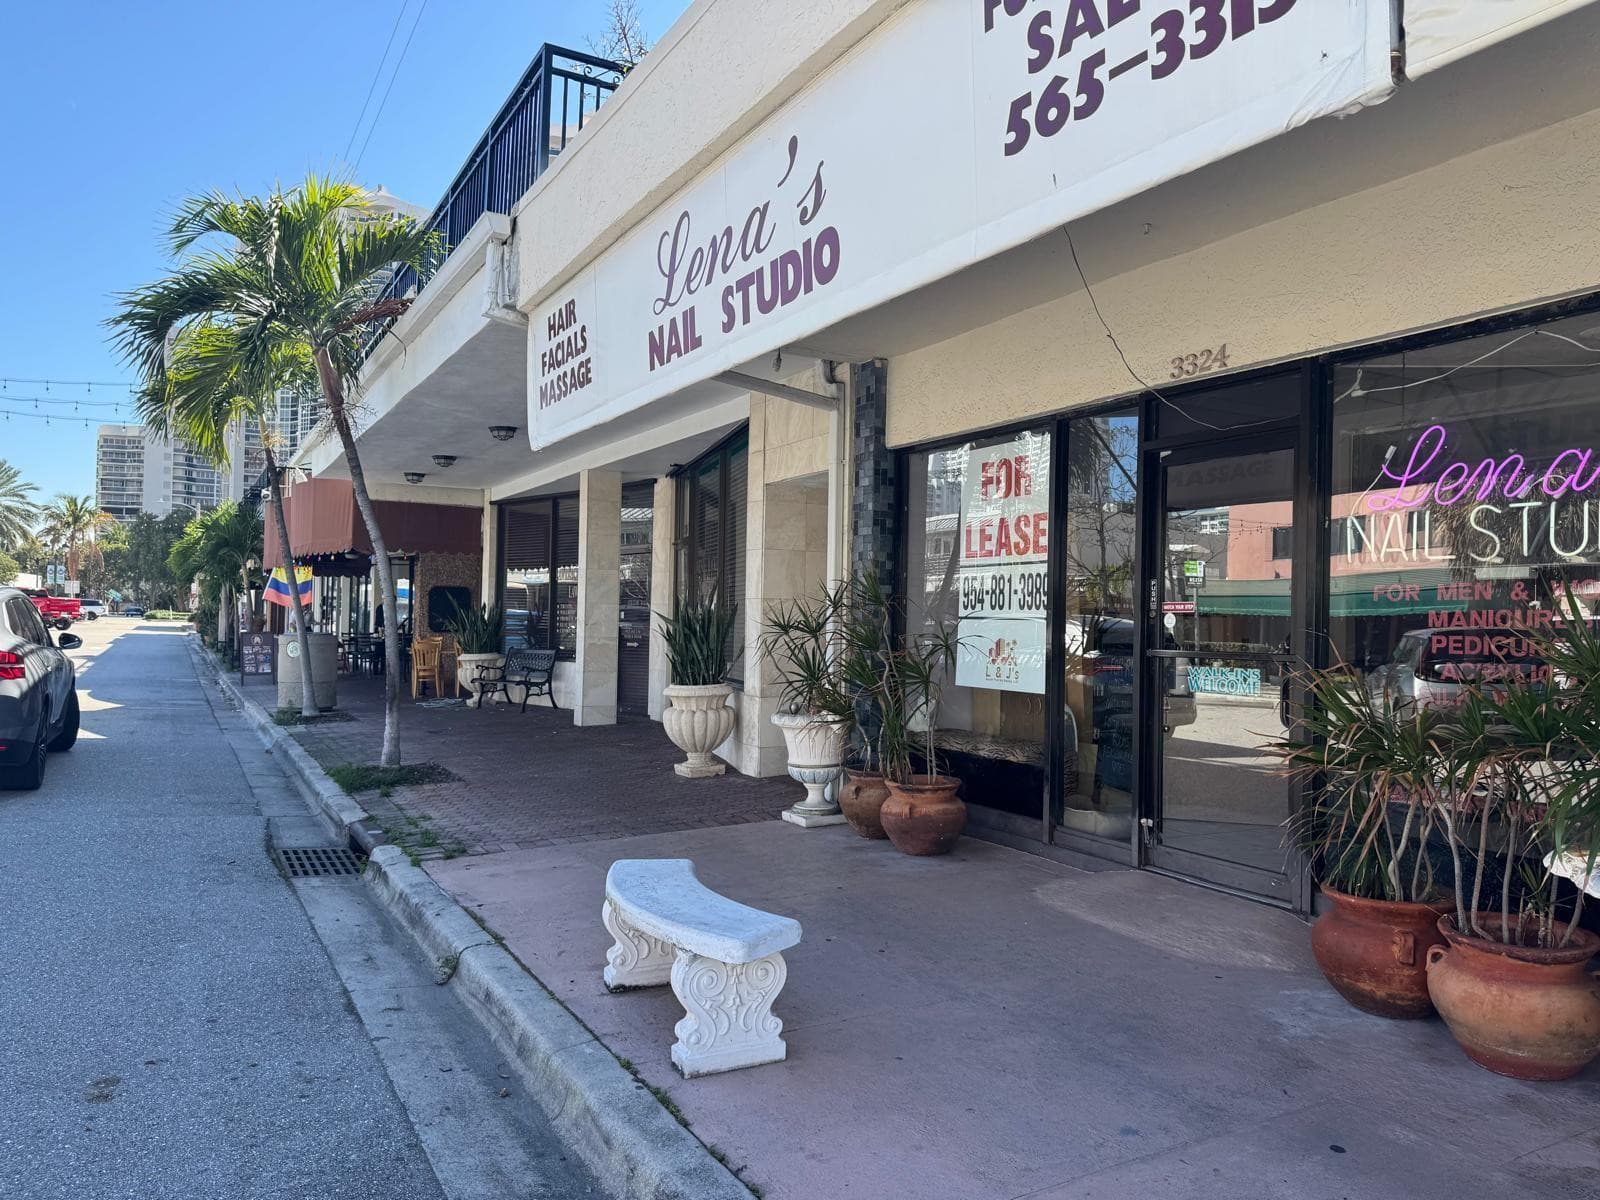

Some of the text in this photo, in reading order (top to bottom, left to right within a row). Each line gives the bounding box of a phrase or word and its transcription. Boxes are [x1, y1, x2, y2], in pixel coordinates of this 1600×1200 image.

[652, 134, 827, 317] Lena's
[547, 297, 578, 342] HAIR
[647, 225, 841, 373] NAIL STUDIO
[541, 324, 588, 378] FACIALS
[1169, 343, 1231, 379] 3324
[539, 356, 593, 410] MASSAGE
[981, 454, 1032, 502] FOR
[965, 512, 1048, 559] LEASE
[1347, 499, 1600, 563] NAIL STU
[962, 572, 1048, 611] 954-881-3989
[1372, 583, 1421, 602] FOR
[1437, 580, 1494, 601] MEN
[1510, 581, 1529, 600] &
[1431, 635, 1563, 657] PEDICUR
[1187, 665, 1261, 681] WALK-INS
[1187, 676, 1261, 697] WELCOME
